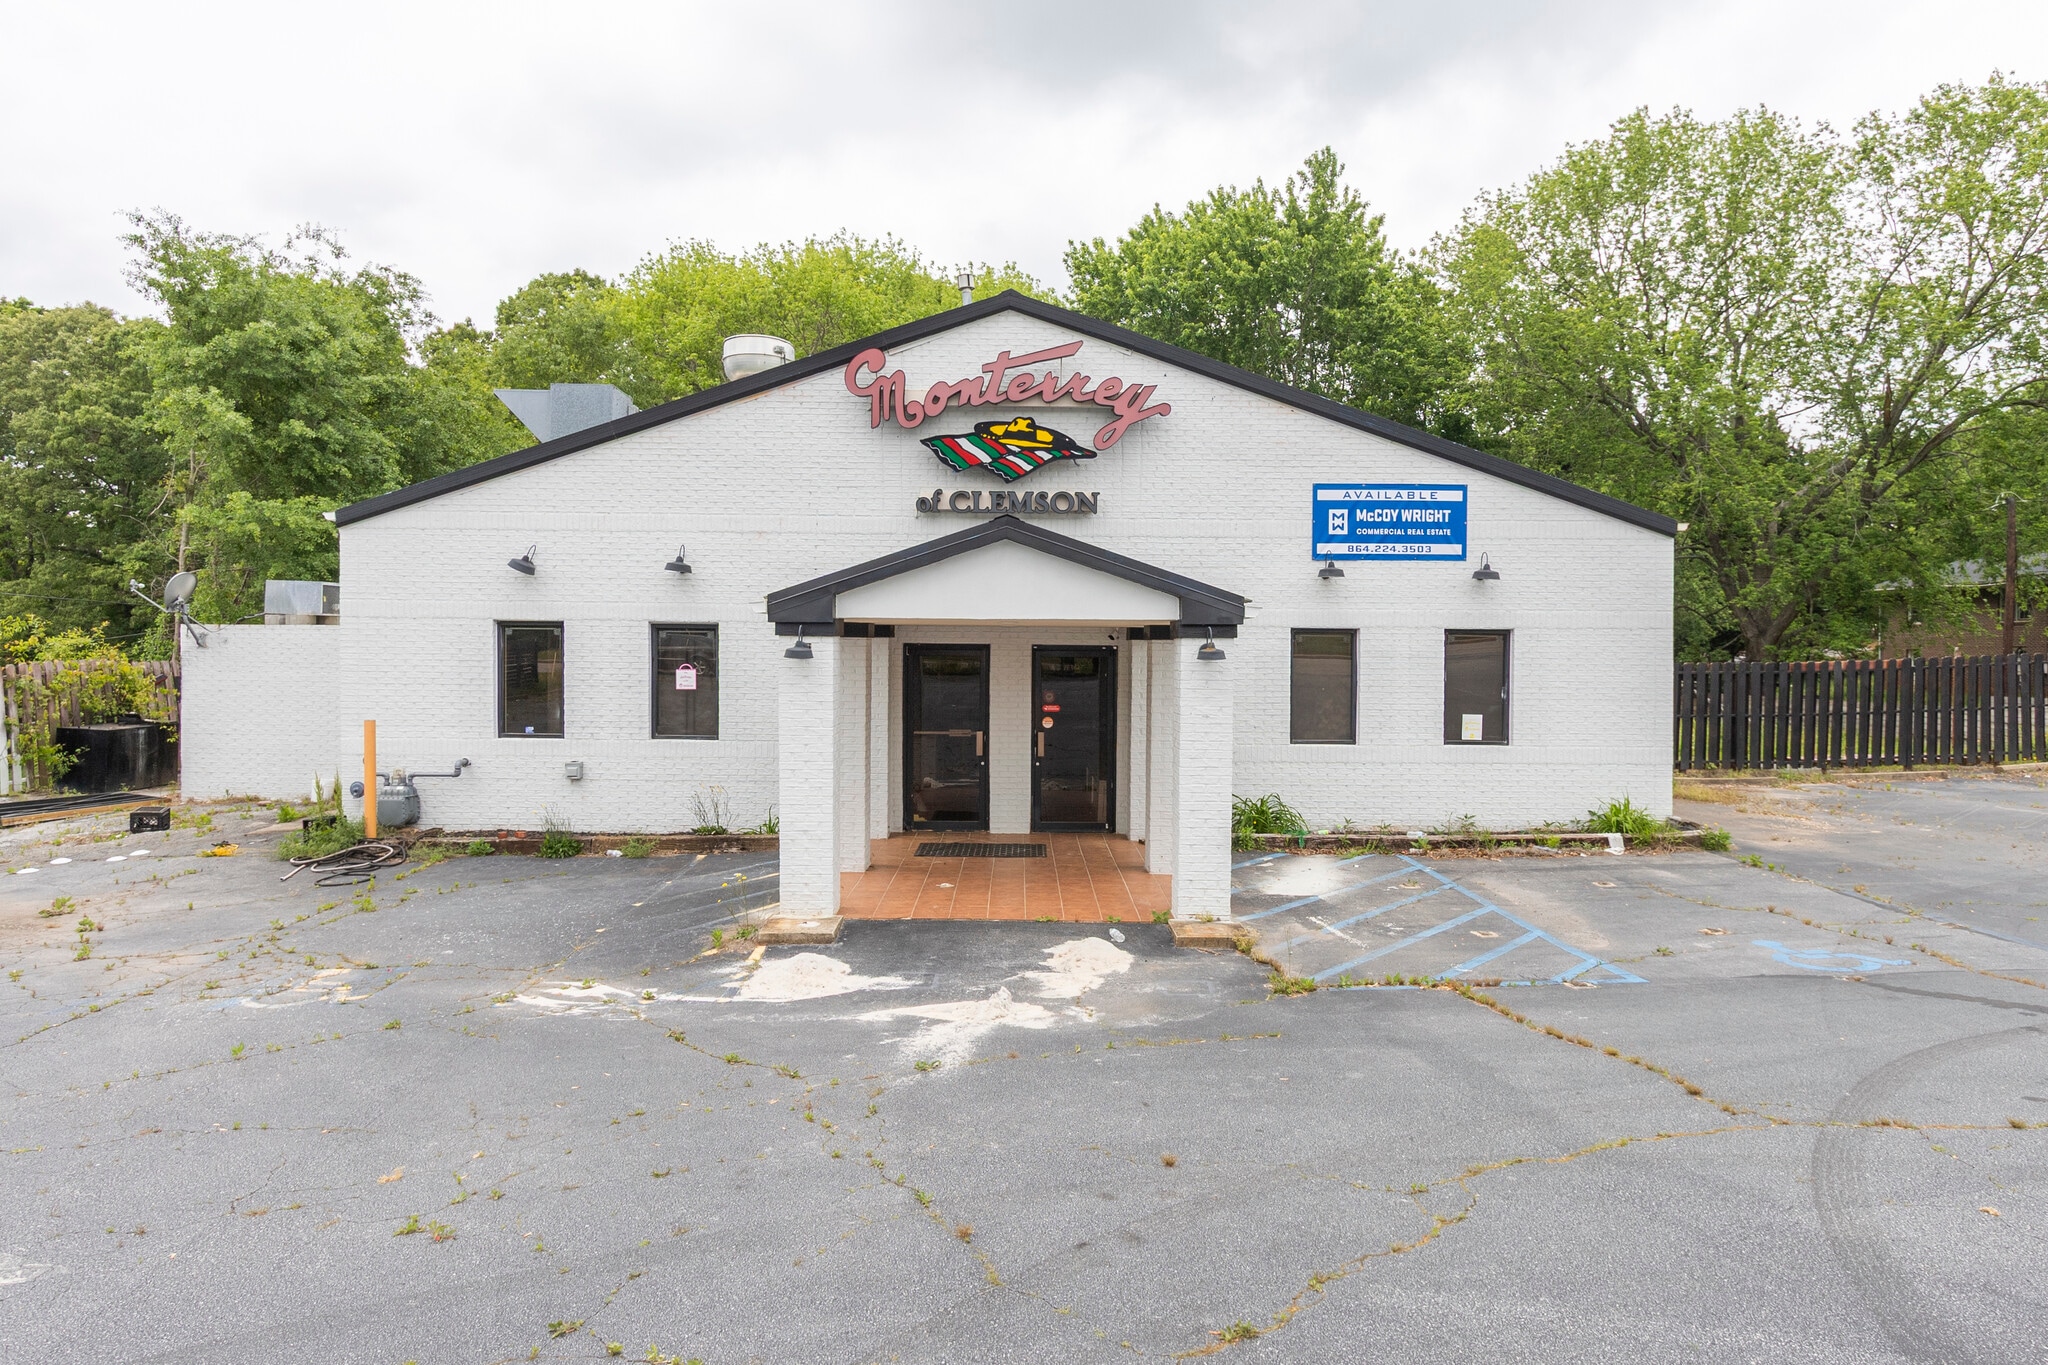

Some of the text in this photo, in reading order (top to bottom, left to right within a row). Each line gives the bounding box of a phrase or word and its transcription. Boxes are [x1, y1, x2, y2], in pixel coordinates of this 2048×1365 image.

[844, 340, 1172, 451] Monterrey
[916, 488, 1101, 514] of CLEMSON
[1343, 491, 1438, 500] AVAILABLE
[1356, 509, 1451, 522] McCOY WRIGHT
[1347, 545, 1432, 553] 864.224.3503
